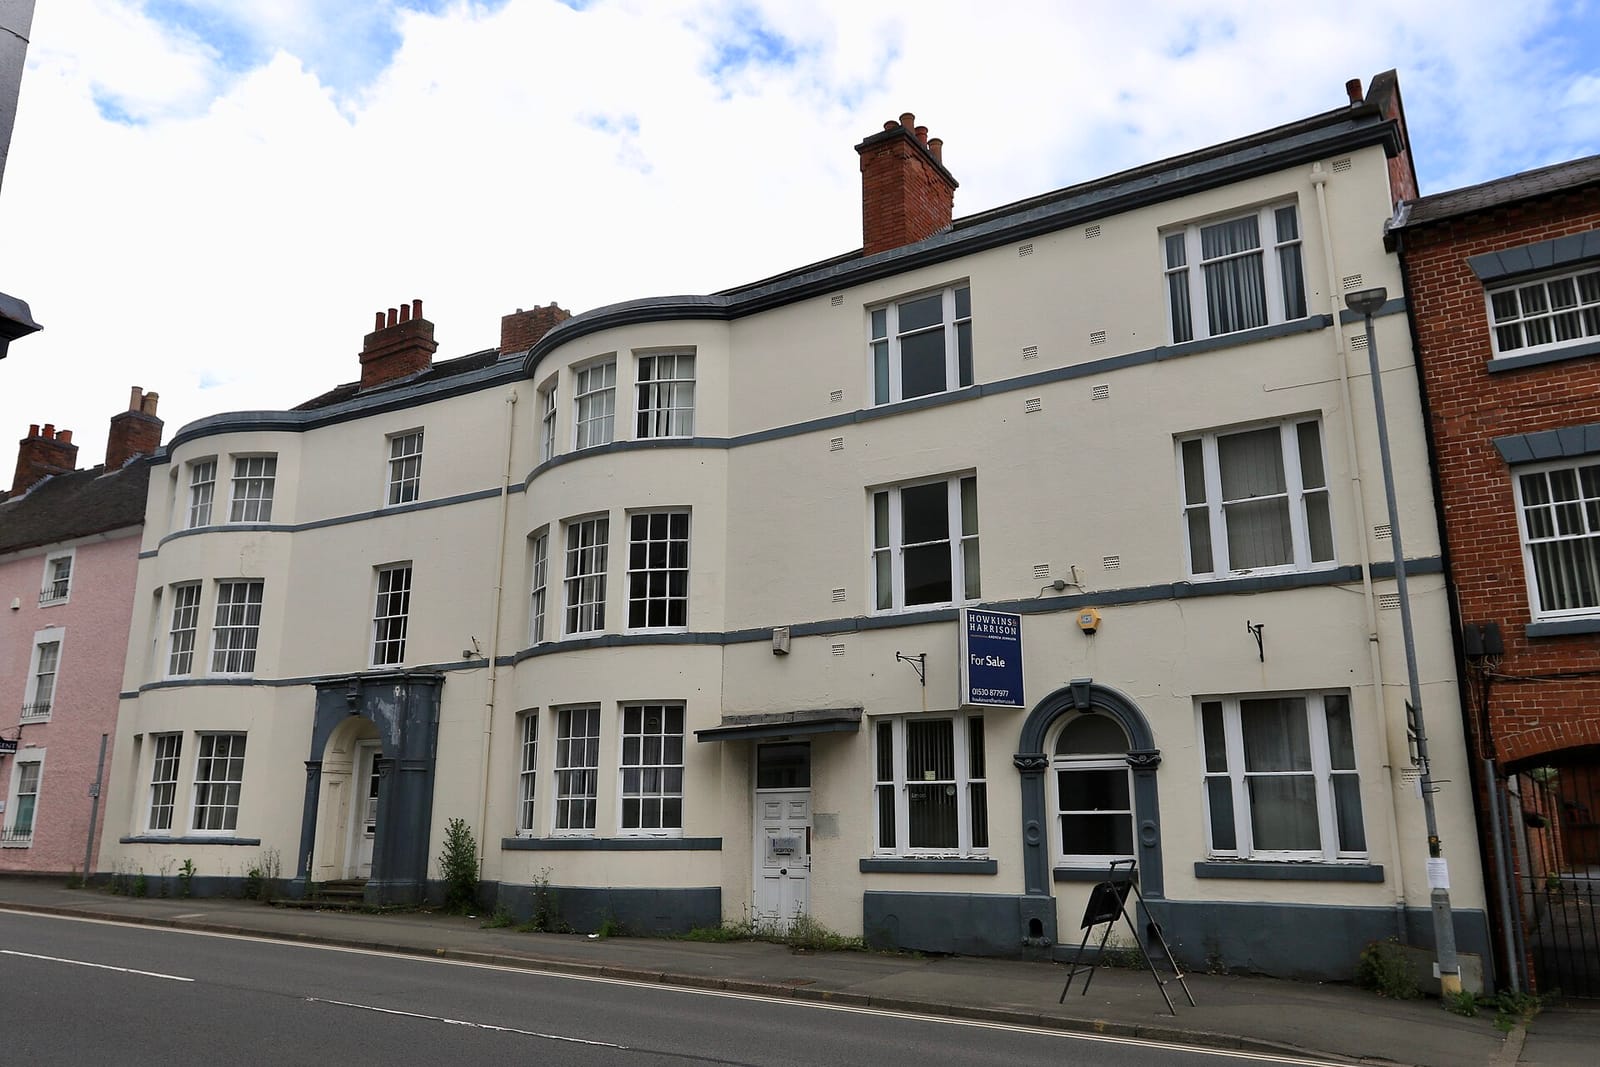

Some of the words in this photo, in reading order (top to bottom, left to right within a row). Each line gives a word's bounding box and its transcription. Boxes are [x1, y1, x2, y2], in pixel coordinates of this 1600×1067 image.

[969, 614, 1012, 626] HOWKINS
[969, 623, 1017, 635] HARRISON
[971, 654, 984, 666] For
[986, 655, 1005, 667] Sale
[971, 687, 989, 696] 01530
[989, 688, 1009, 697] 877977
